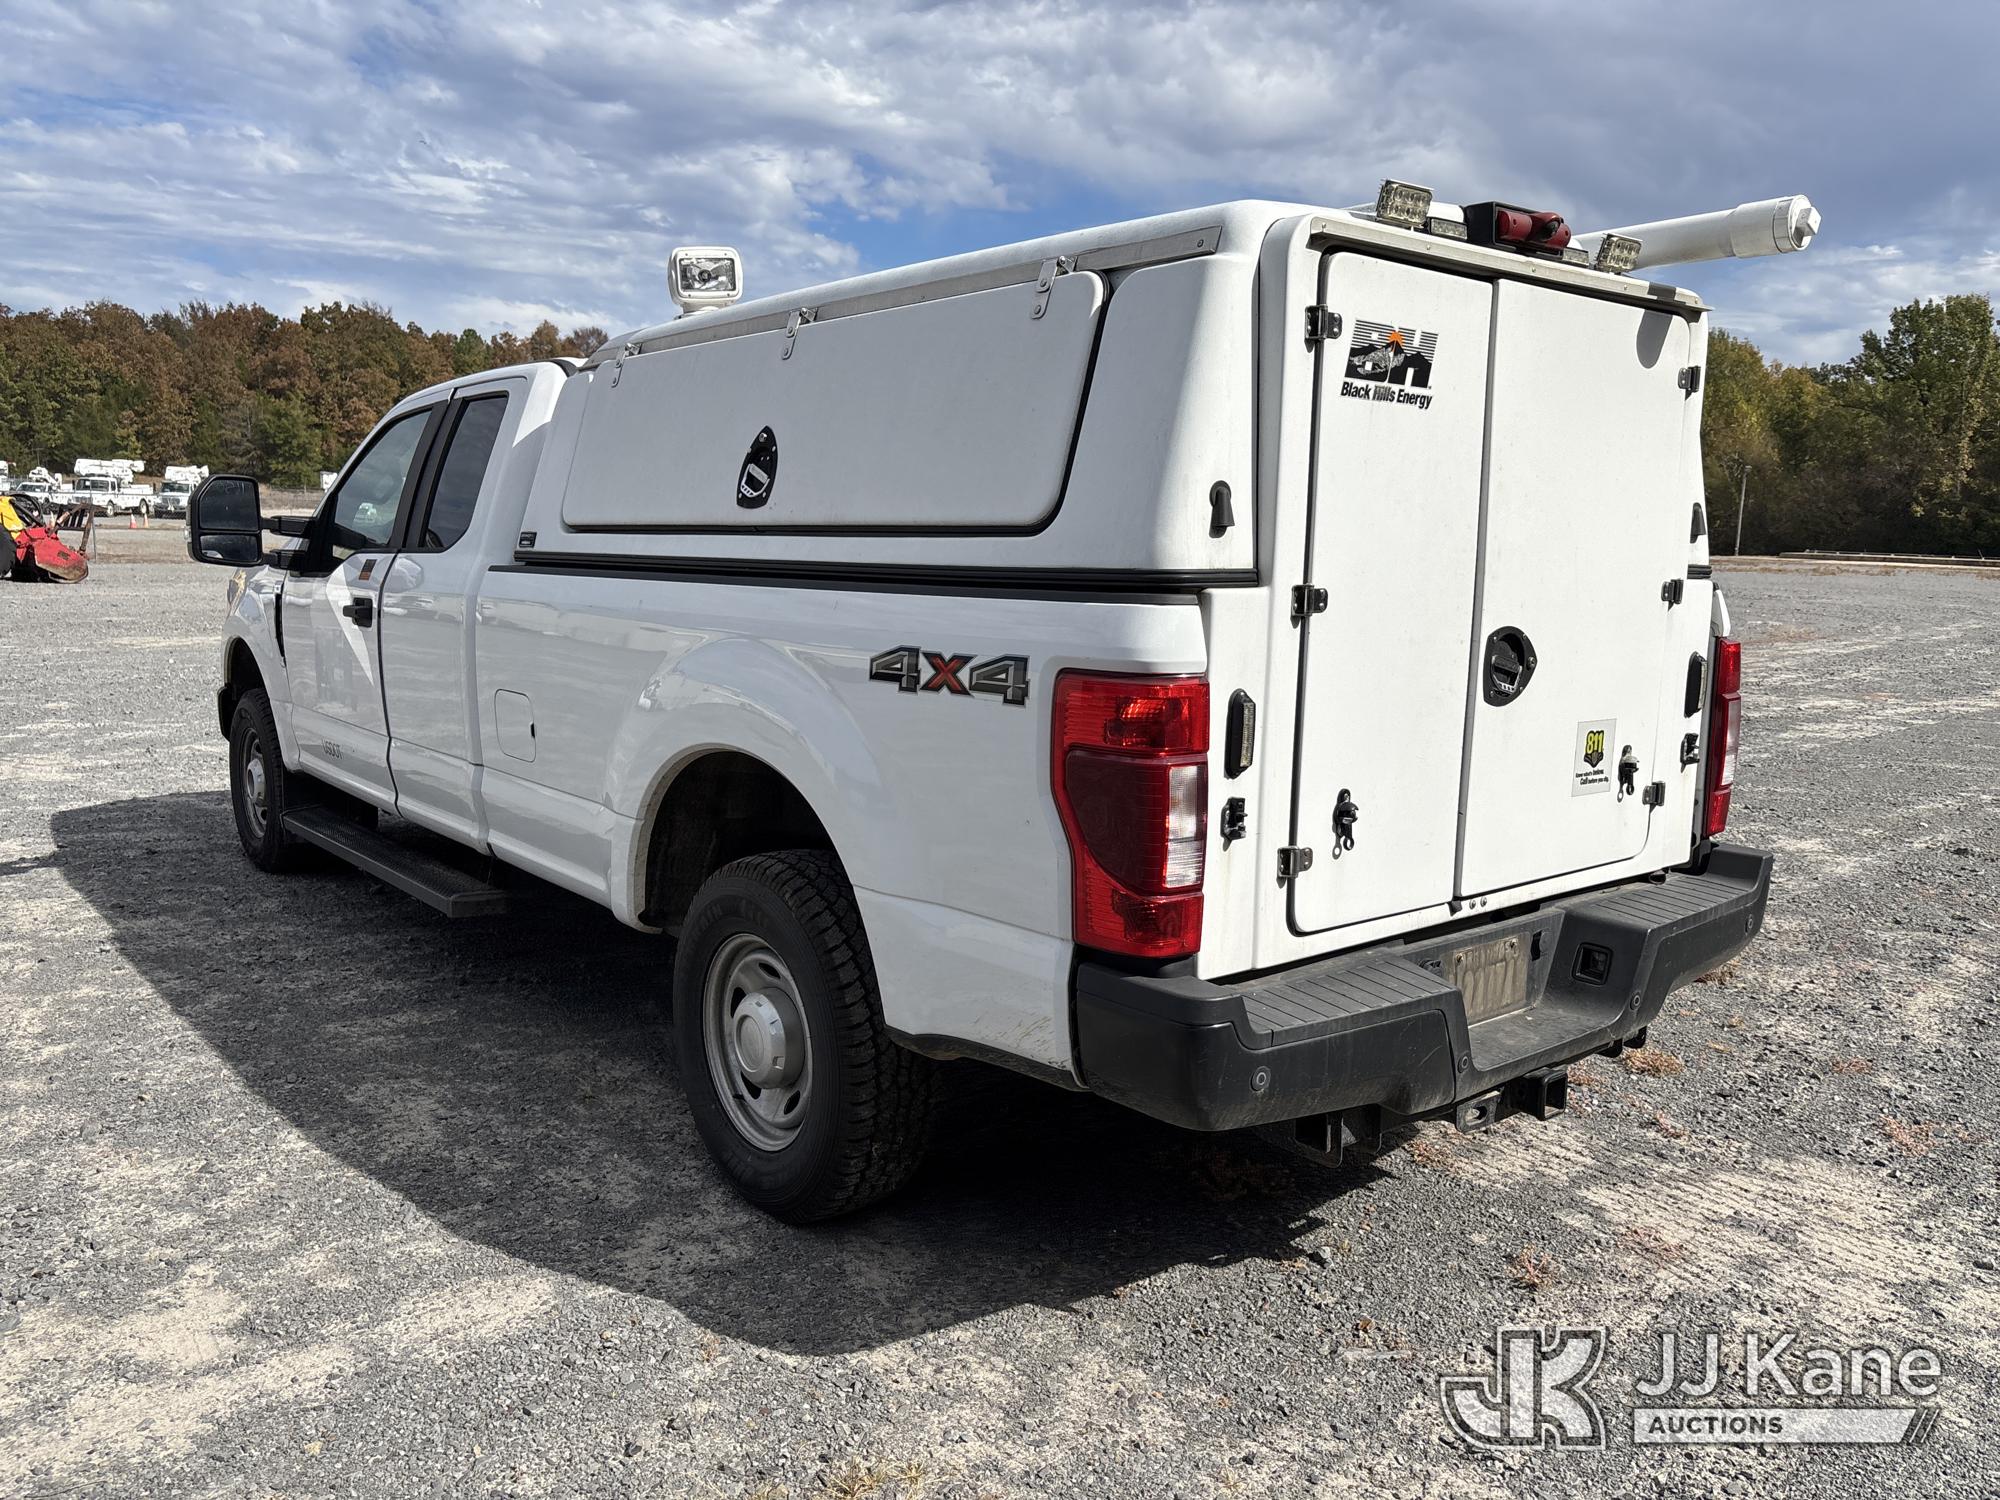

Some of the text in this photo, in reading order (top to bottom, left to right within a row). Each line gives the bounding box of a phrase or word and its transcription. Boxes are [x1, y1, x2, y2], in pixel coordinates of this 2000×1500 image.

[1340, 381, 1433, 410] Black Hills Energy
[1585, 730, 1604, 755] 811
